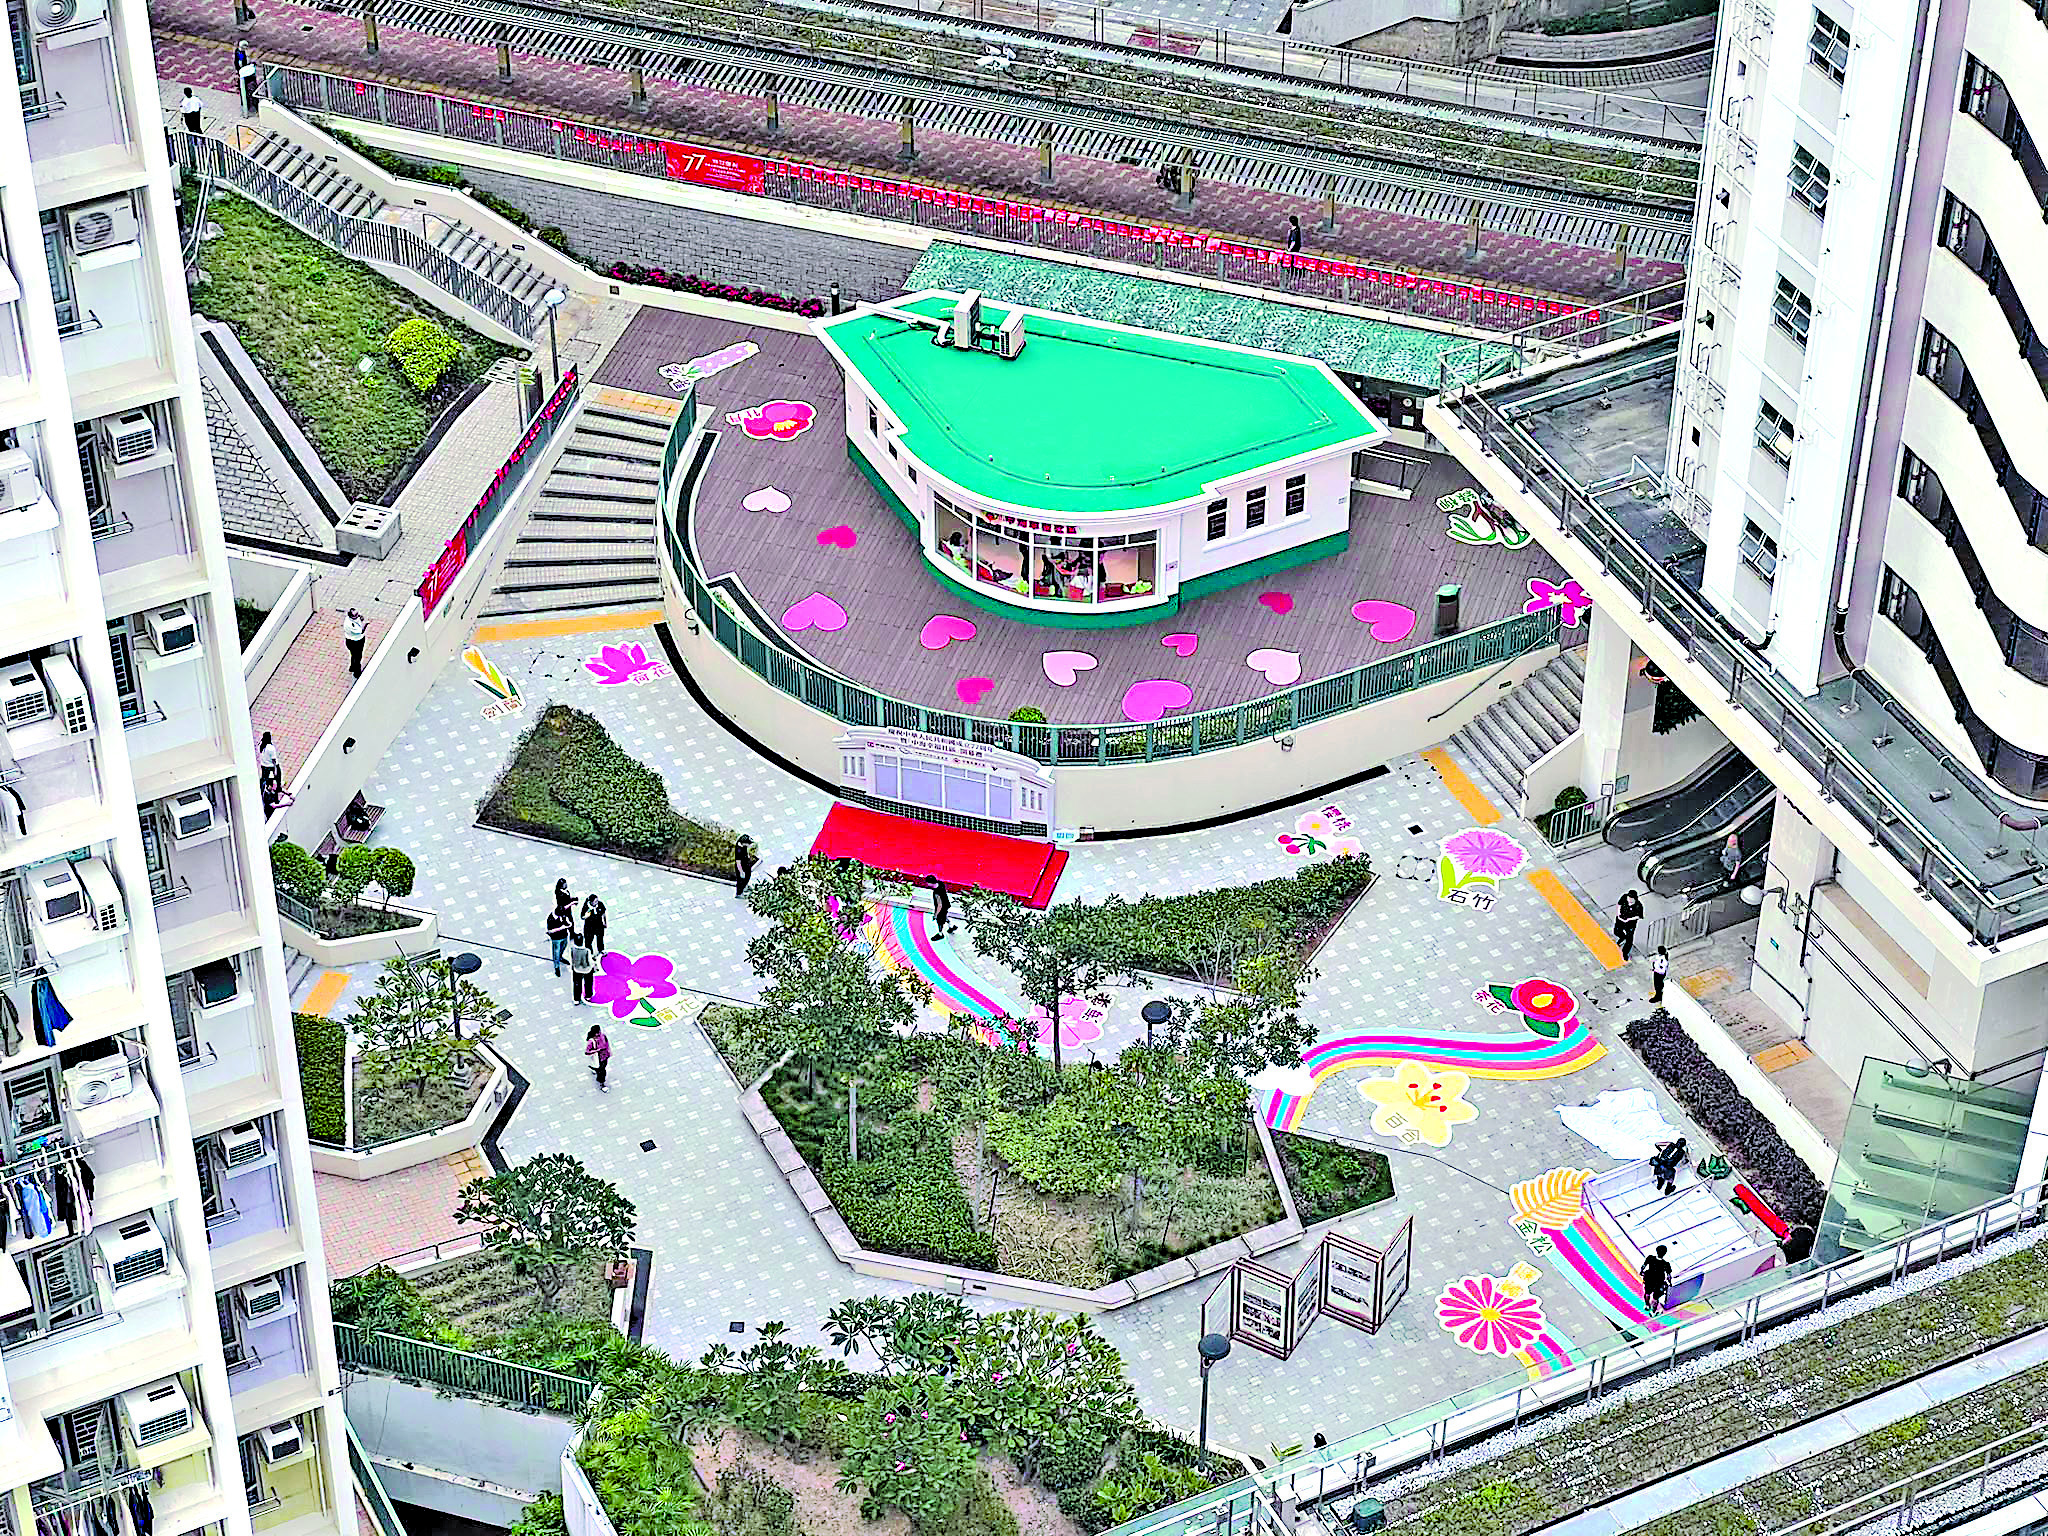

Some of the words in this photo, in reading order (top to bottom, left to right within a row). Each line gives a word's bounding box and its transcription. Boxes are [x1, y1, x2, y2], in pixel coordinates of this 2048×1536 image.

[681, 153, 707, 172] 77
[632, 664, 672, 684] 荷花
[1447, 888, 1495, 911] 石竹
[1474, 989, 1505, 1014] 茶花
[1384, 1111, 1421, 1143] 百合
[1514, 1219, 1554, 1255] 金松
